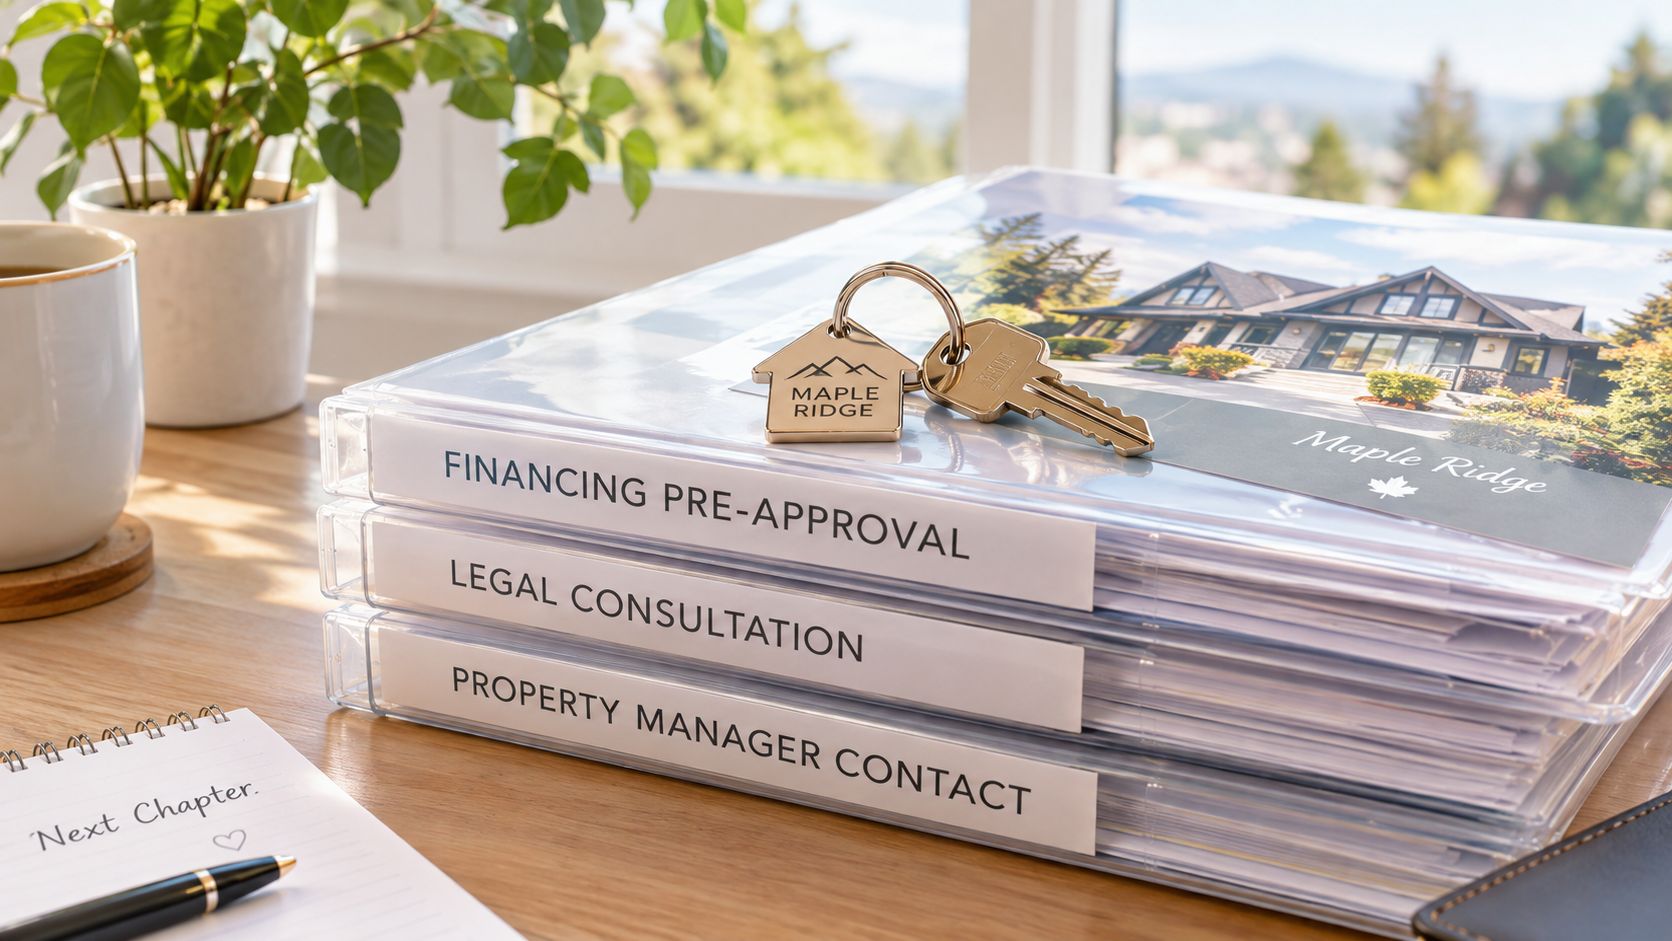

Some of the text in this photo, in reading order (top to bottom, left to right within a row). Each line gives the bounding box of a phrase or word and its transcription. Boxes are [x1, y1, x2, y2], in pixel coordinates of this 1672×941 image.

[791, 386, 879, 401] MAPLE
[794, 403, 873, 418] RIDGE
[1292, 430, 1547, 494] Maple Ridge
[444, 450, 970, 561] FINANCING PRE-APPROVAL
[450, 559, 864, 663] LEGAL CONSULTATION
[452, 666, 1032, 816] PROPERTY MANAGER CONTACT
[30, 783, 259, 851] Next Chapter.
